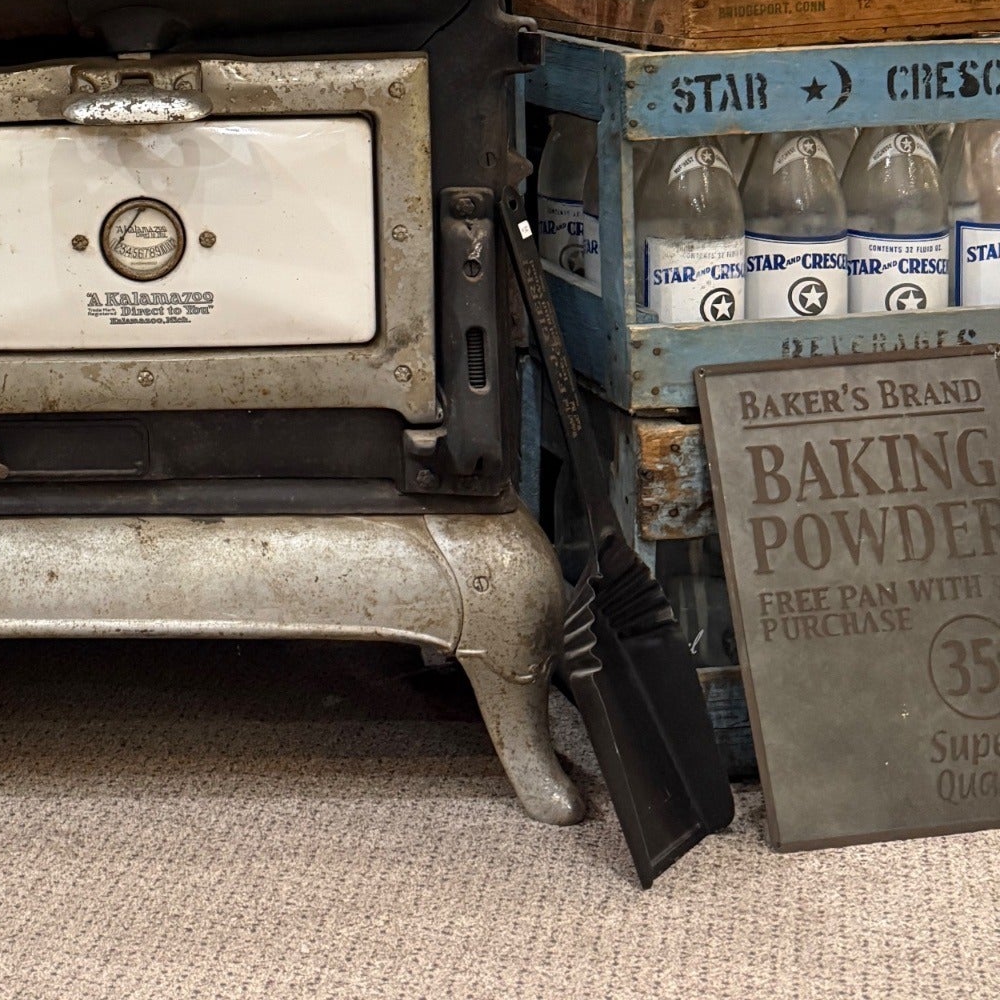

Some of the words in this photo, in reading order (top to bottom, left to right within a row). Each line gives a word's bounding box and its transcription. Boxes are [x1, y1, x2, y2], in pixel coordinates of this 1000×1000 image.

[718, 2, 793, 19] BRIDGEPORT,
[671, 72, 768, 113] STAR
[869, 244, 903, 254] CONTENTS
[906, 244, 914, 253] 32
[916, 244, 934, 253] FLUID
[747, 253, 786, 272] STAR
[786, 255, 801, 266] AND
[882, 261, 898, 271] AND
[653, 264, 697, 286] STAR
[105, 291, 214, 306] Kalamazoo
[120, 305, 165, 316] Direct
[167, 306, 182, 316] to
[740, 382, 870, 421] BAKER'S
[877, 379, 982, 410] BRAND
[745, 428, 996, 504] BAKING
[757, 586, 831, 617] FREE
[838, 581, 899, 610] PAN
[908, 573, 983, 602] WITH
[760, 606, 913, 643] PURCHASE
